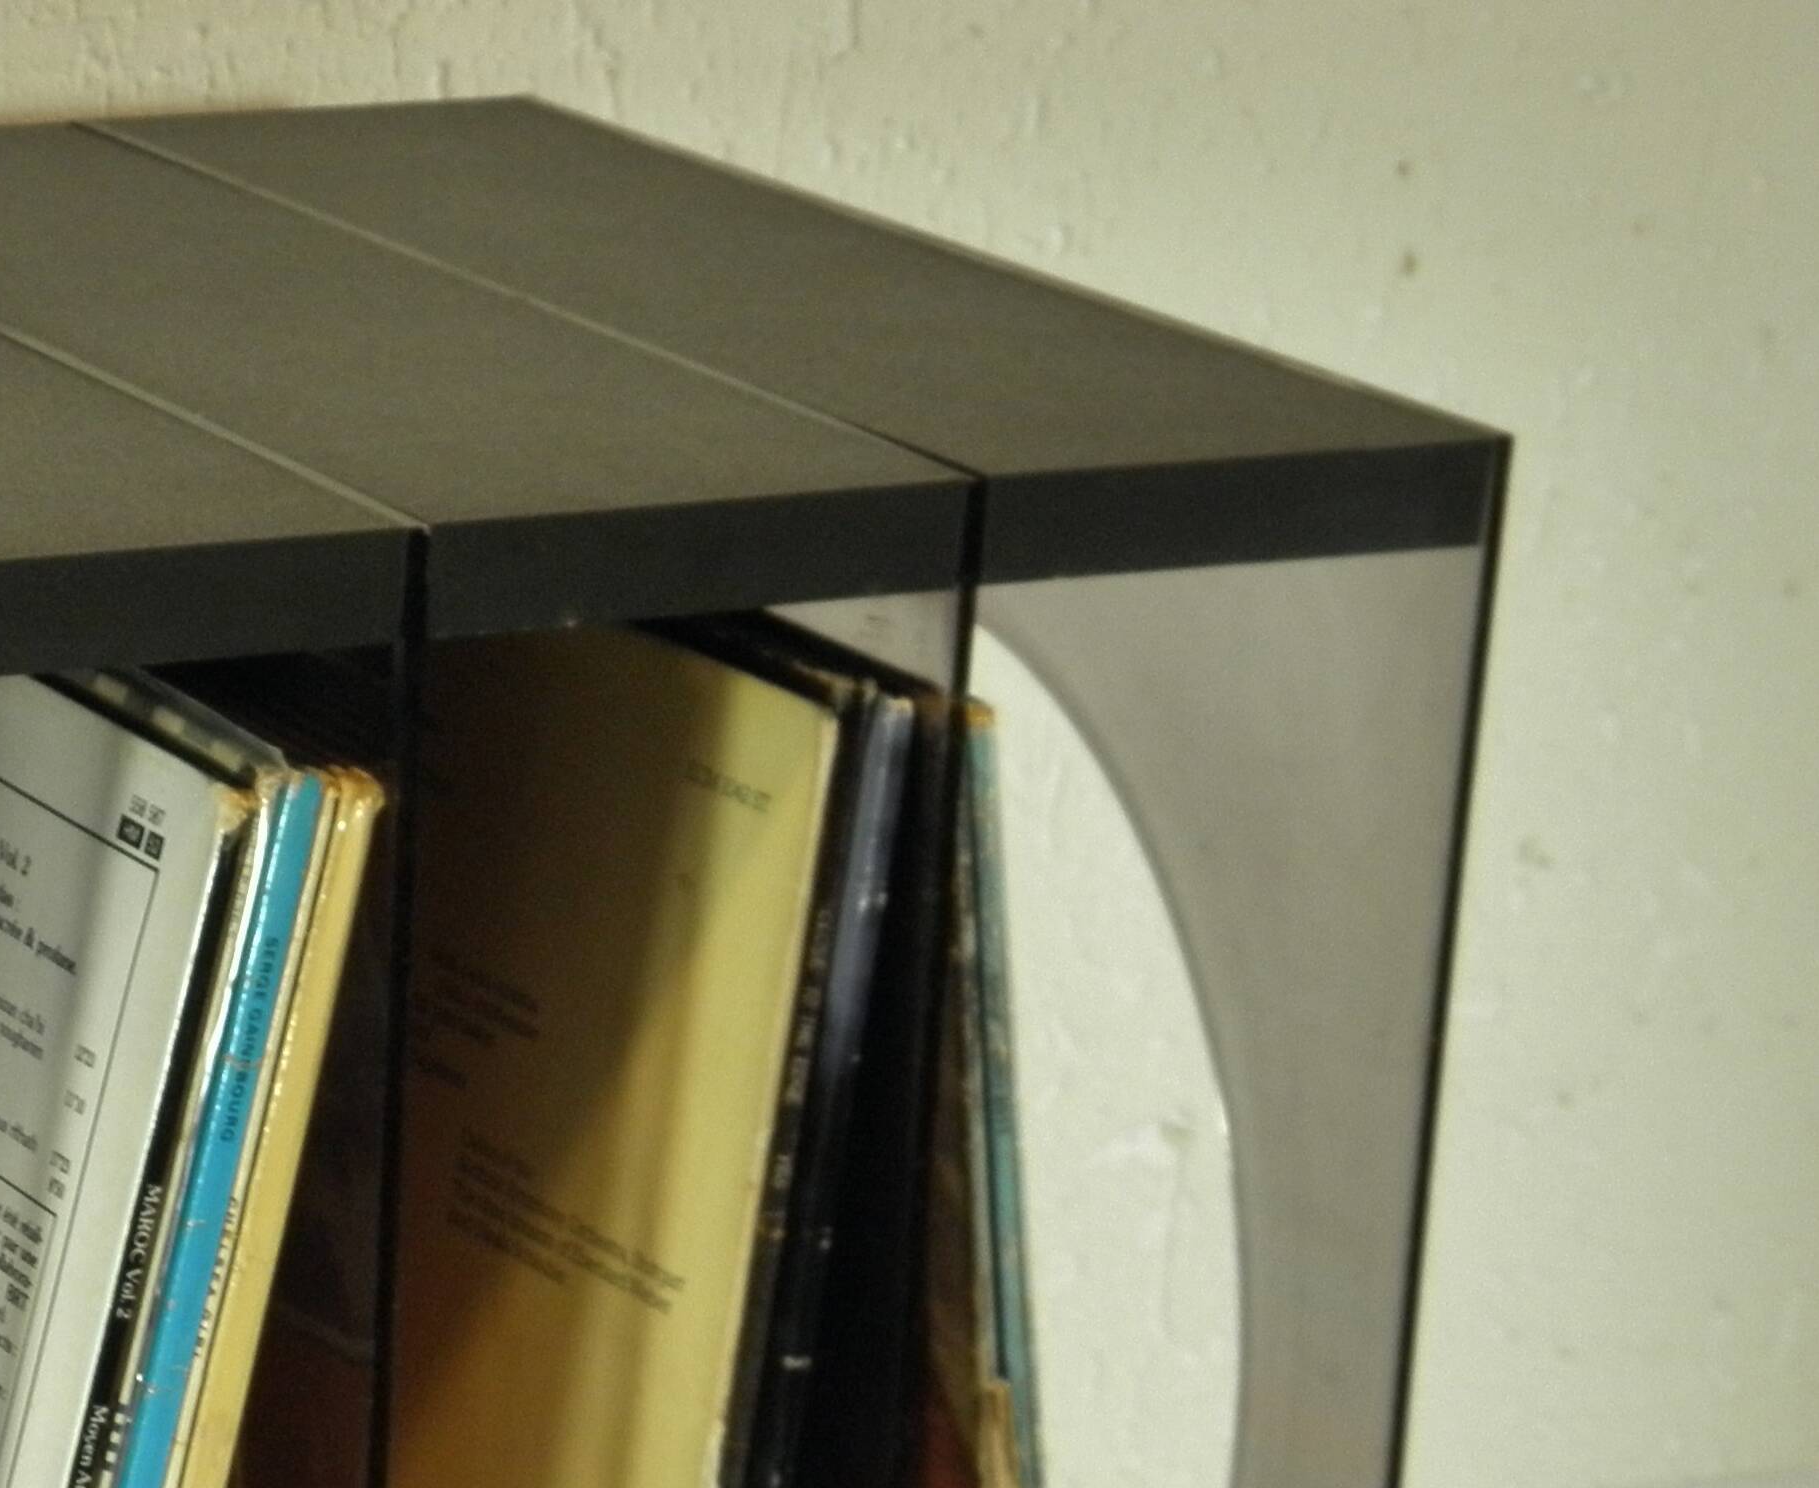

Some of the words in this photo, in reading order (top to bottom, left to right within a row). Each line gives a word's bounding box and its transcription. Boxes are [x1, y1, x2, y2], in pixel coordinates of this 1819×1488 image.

[256, 937, 280, 1001] SERGE
[128, 1184, 163, 1265] MAROC
[115, 1306, 133, 1321] 2
[78, 1404, 110, 1467] Moyen
